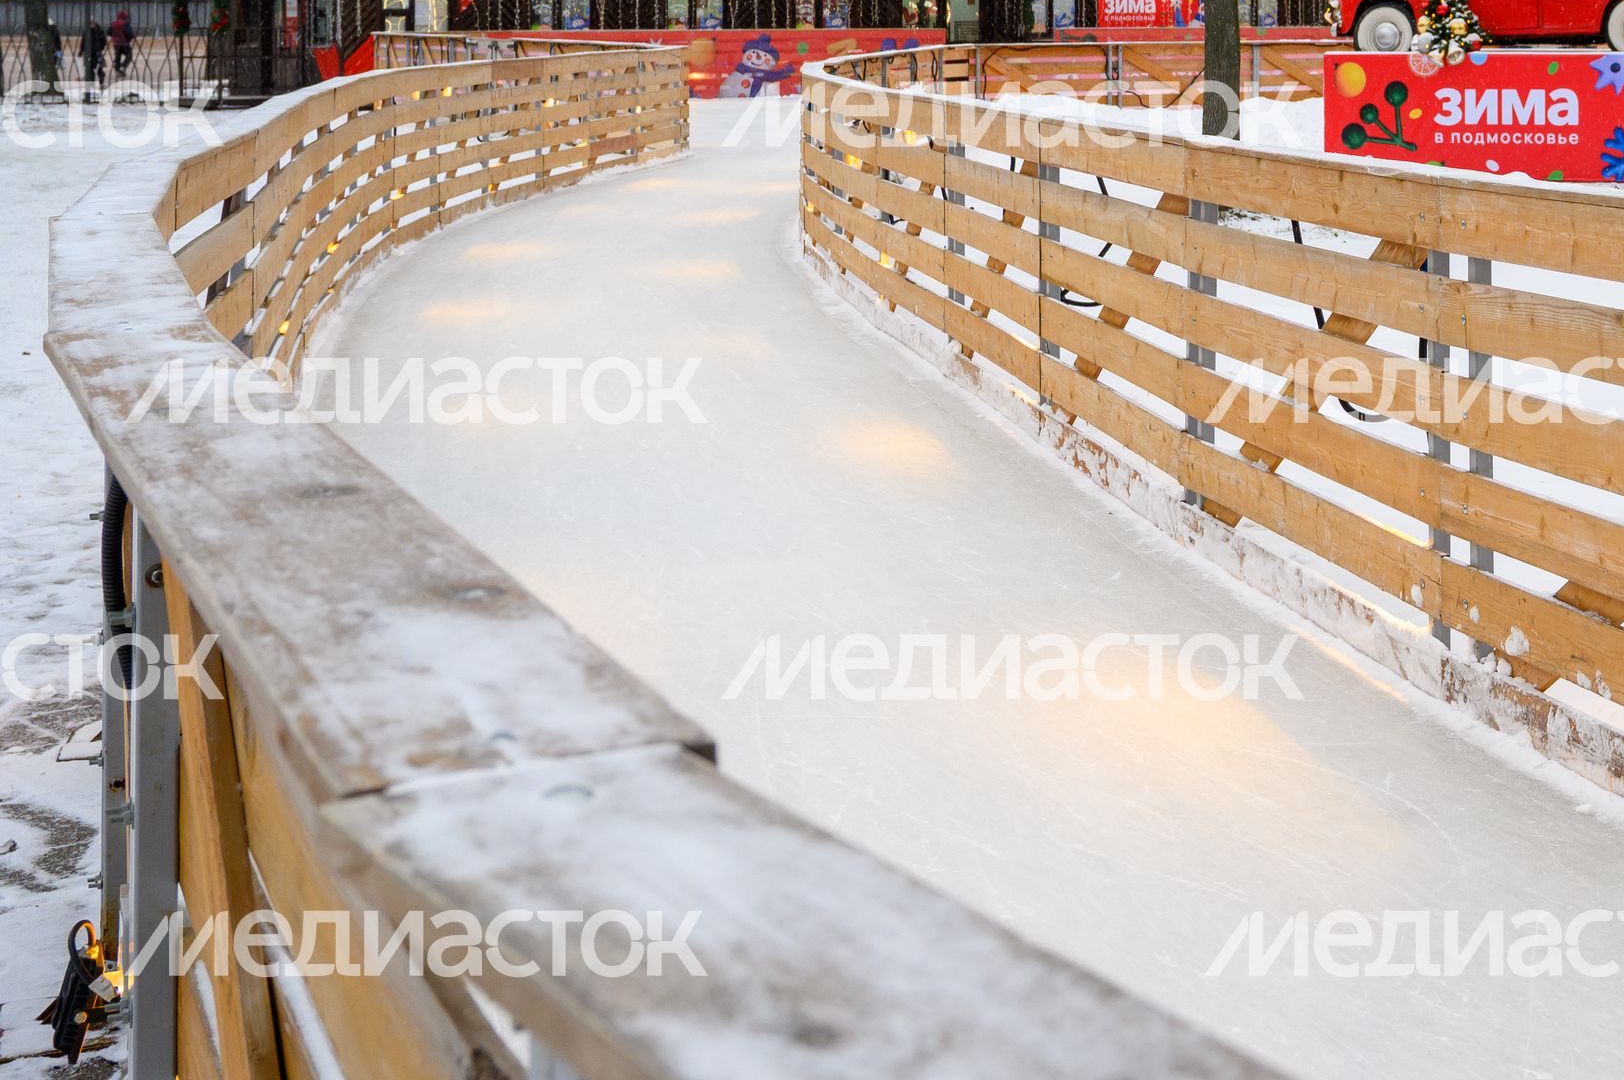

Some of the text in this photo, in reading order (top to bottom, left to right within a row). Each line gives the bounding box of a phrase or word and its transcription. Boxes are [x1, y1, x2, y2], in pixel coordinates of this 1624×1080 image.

[1433, 87, 1580, 126] зима
[1434, 132, 1580, 146] в подмосковье
